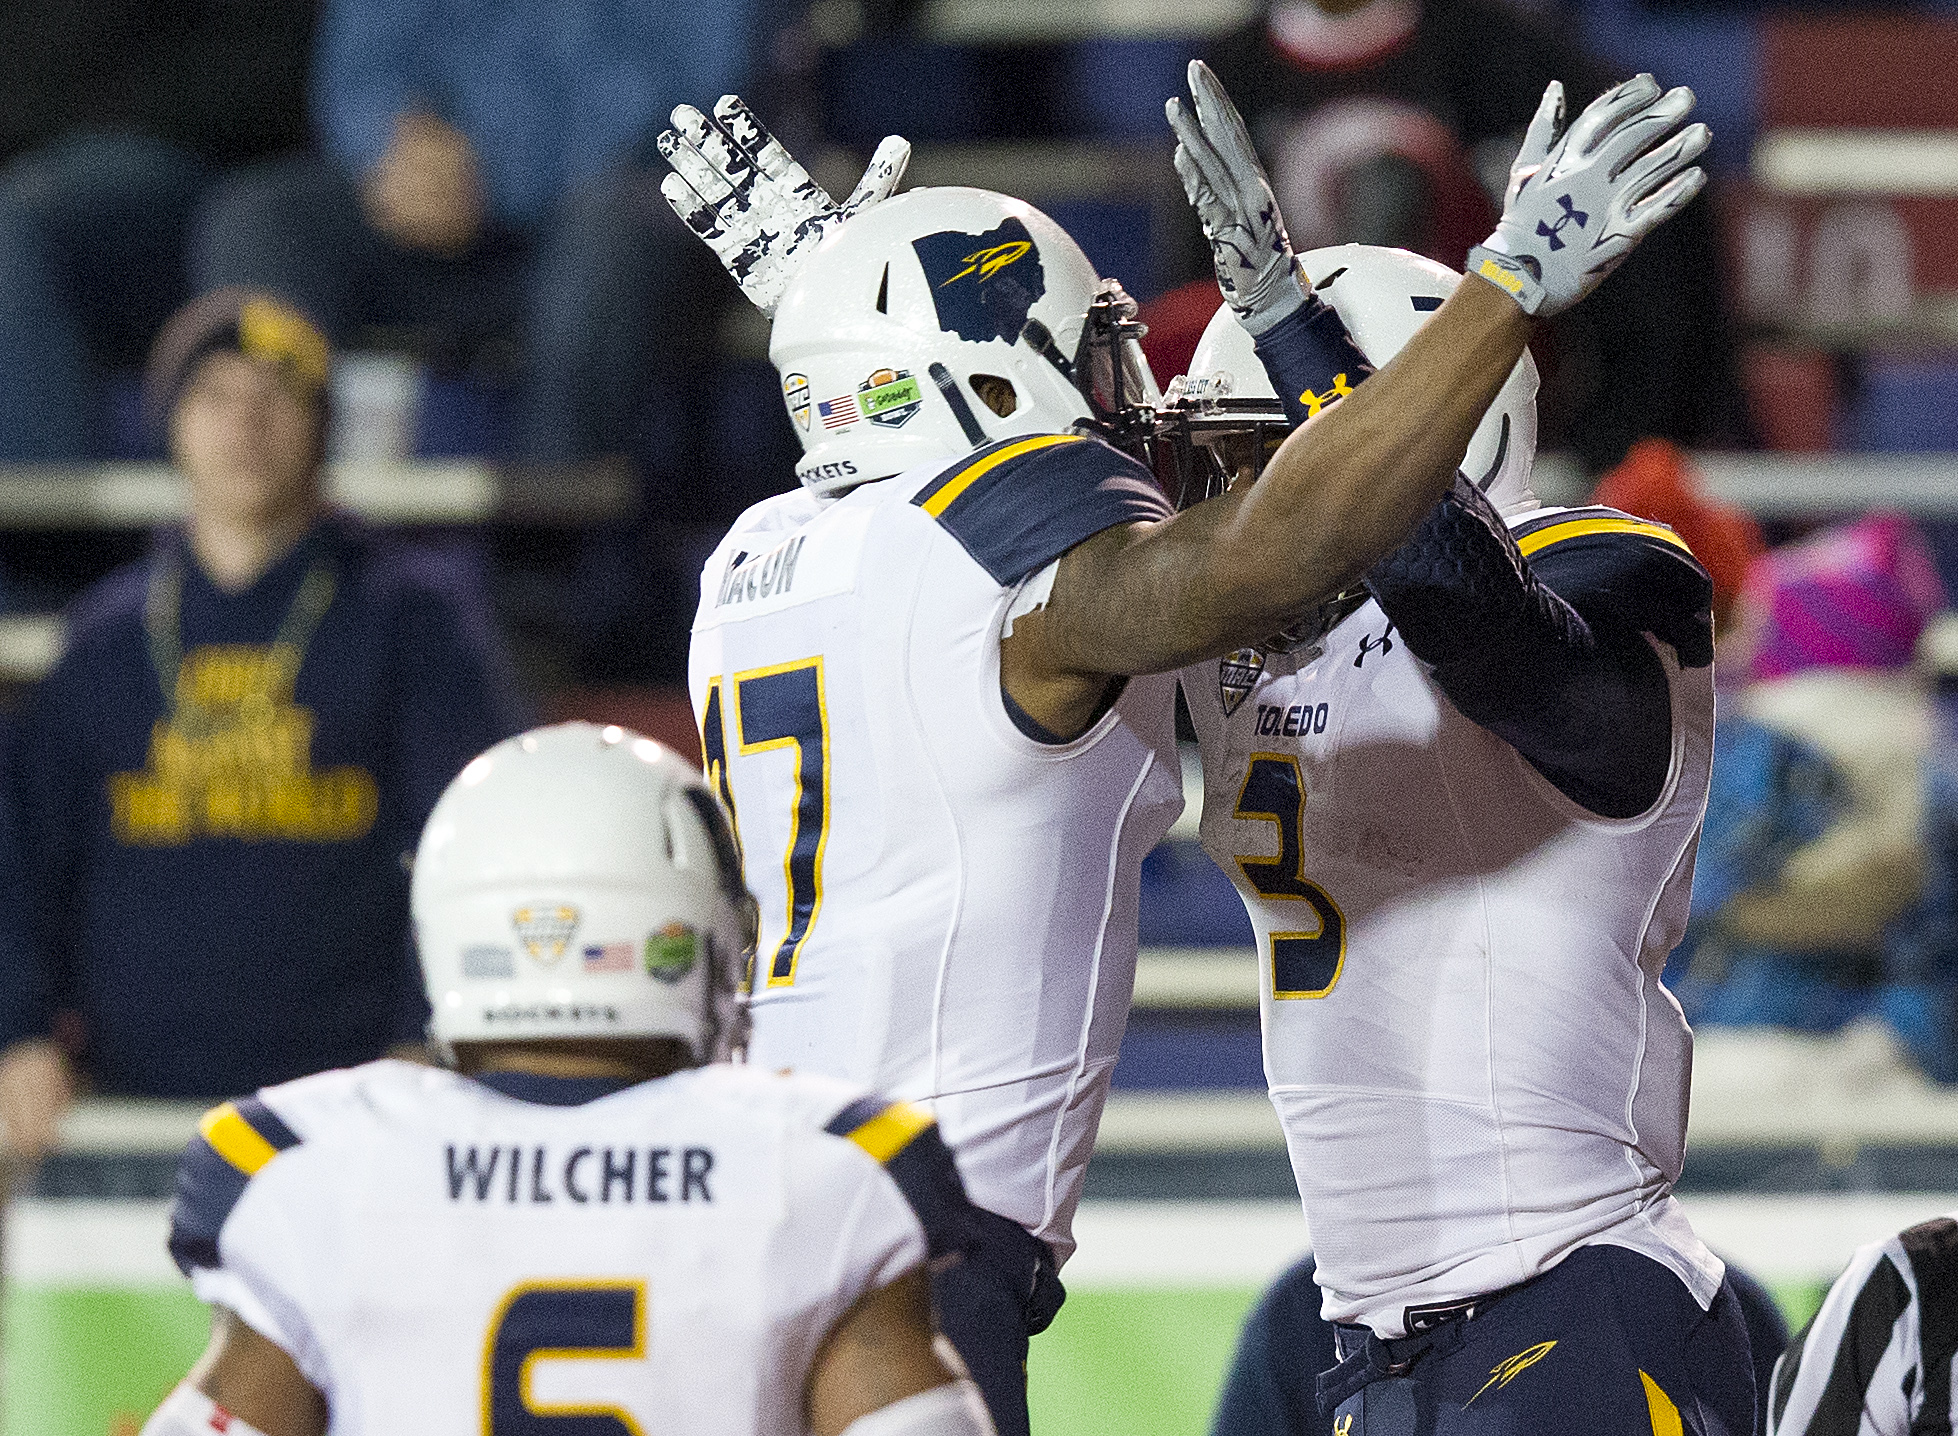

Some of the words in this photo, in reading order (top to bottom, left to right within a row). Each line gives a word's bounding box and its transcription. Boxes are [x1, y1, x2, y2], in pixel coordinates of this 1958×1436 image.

[1254, 702, 1329, 737] TOLEDO
[1232, 752, 1347, 1000] 3
[445, 1144, 714, 1204] WILCHER
